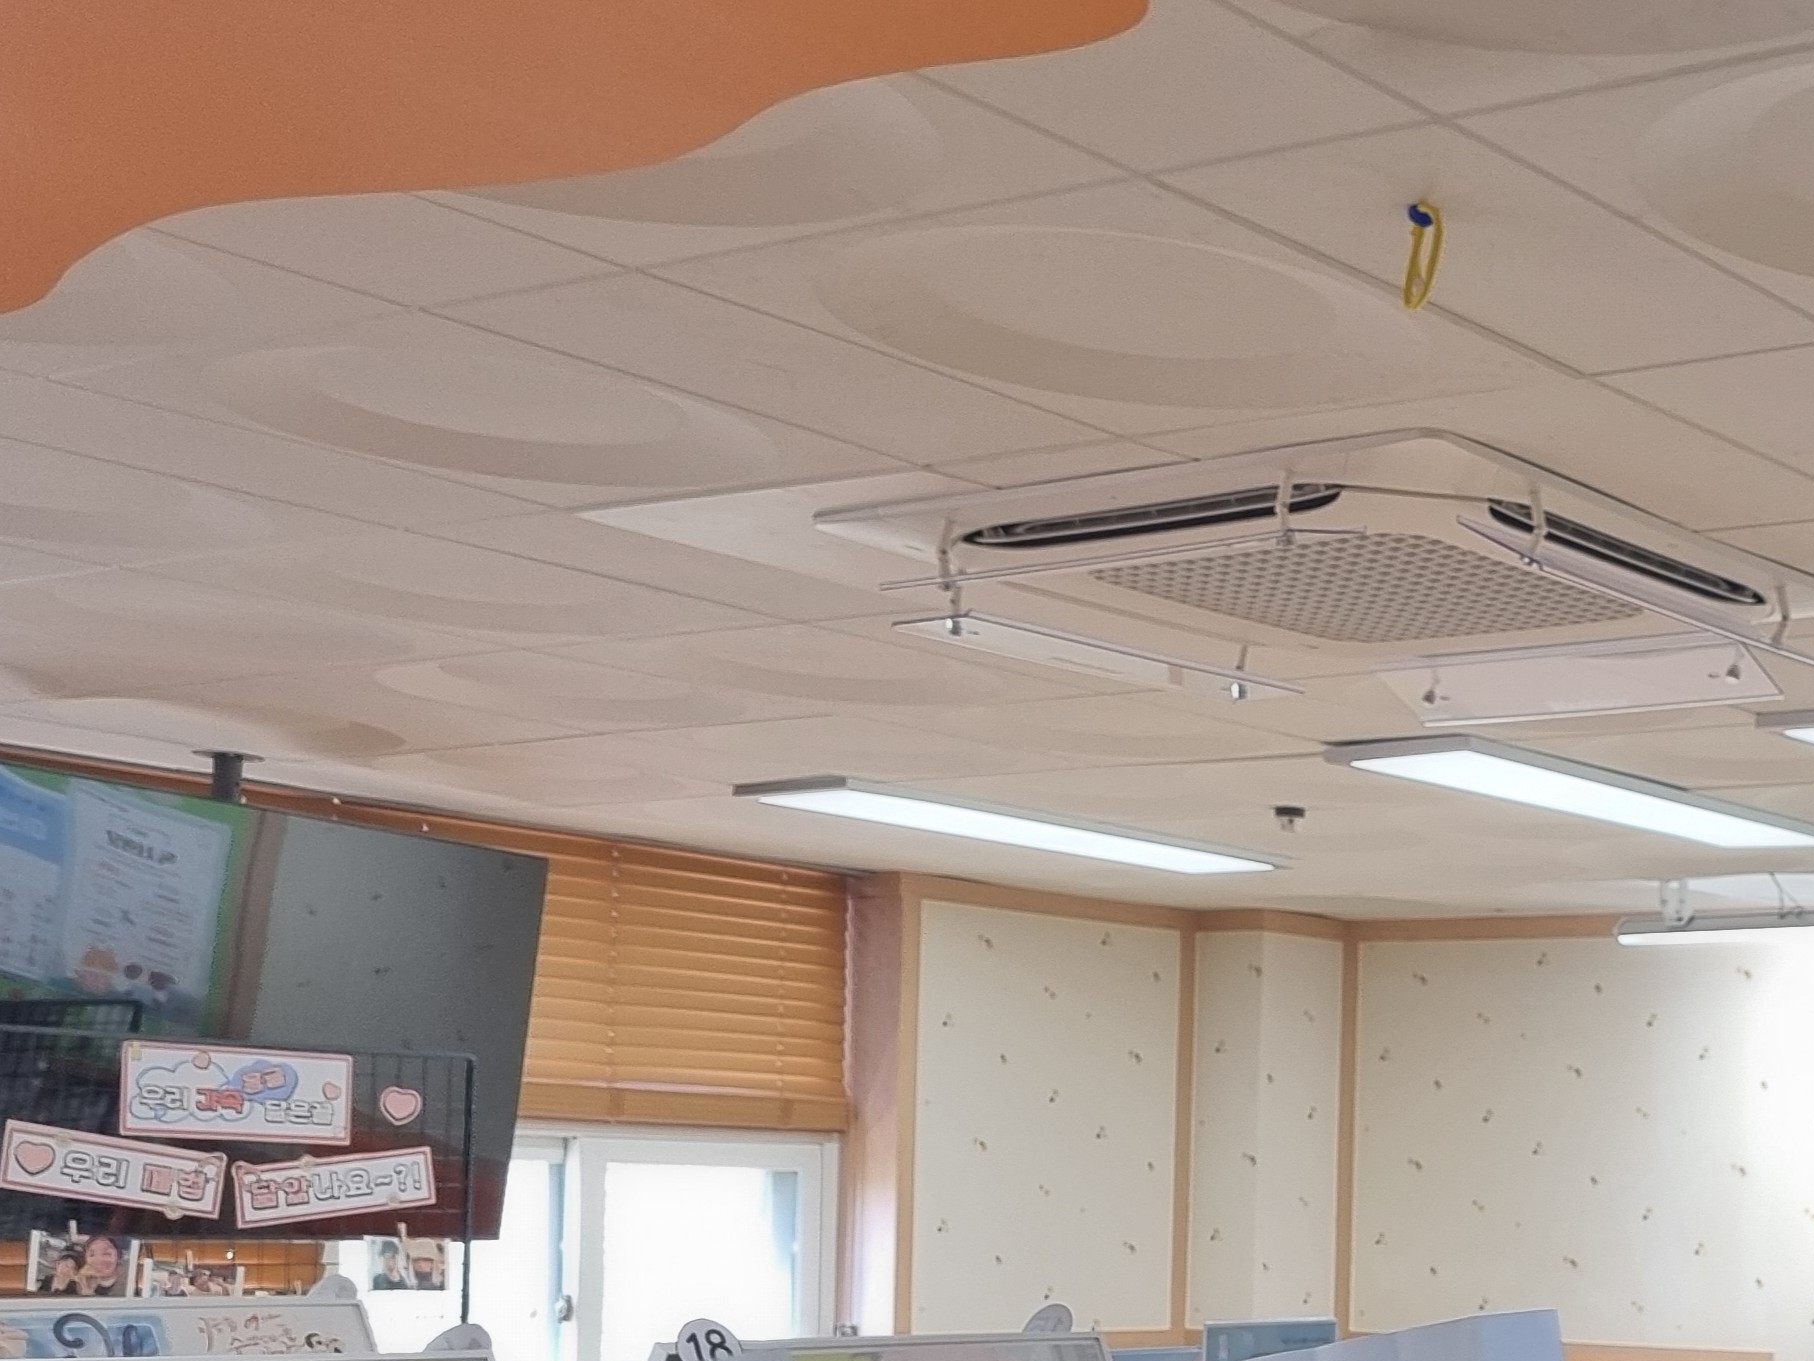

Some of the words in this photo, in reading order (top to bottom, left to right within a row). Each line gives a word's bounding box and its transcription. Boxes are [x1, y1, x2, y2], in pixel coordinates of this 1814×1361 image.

[138, 1084, 190, 1111] 우리
[195, 1087, 246, 1115] 가족
[60, 1150, 131, 1189] 우리
[140, 1162, 208, 1202] 제법
